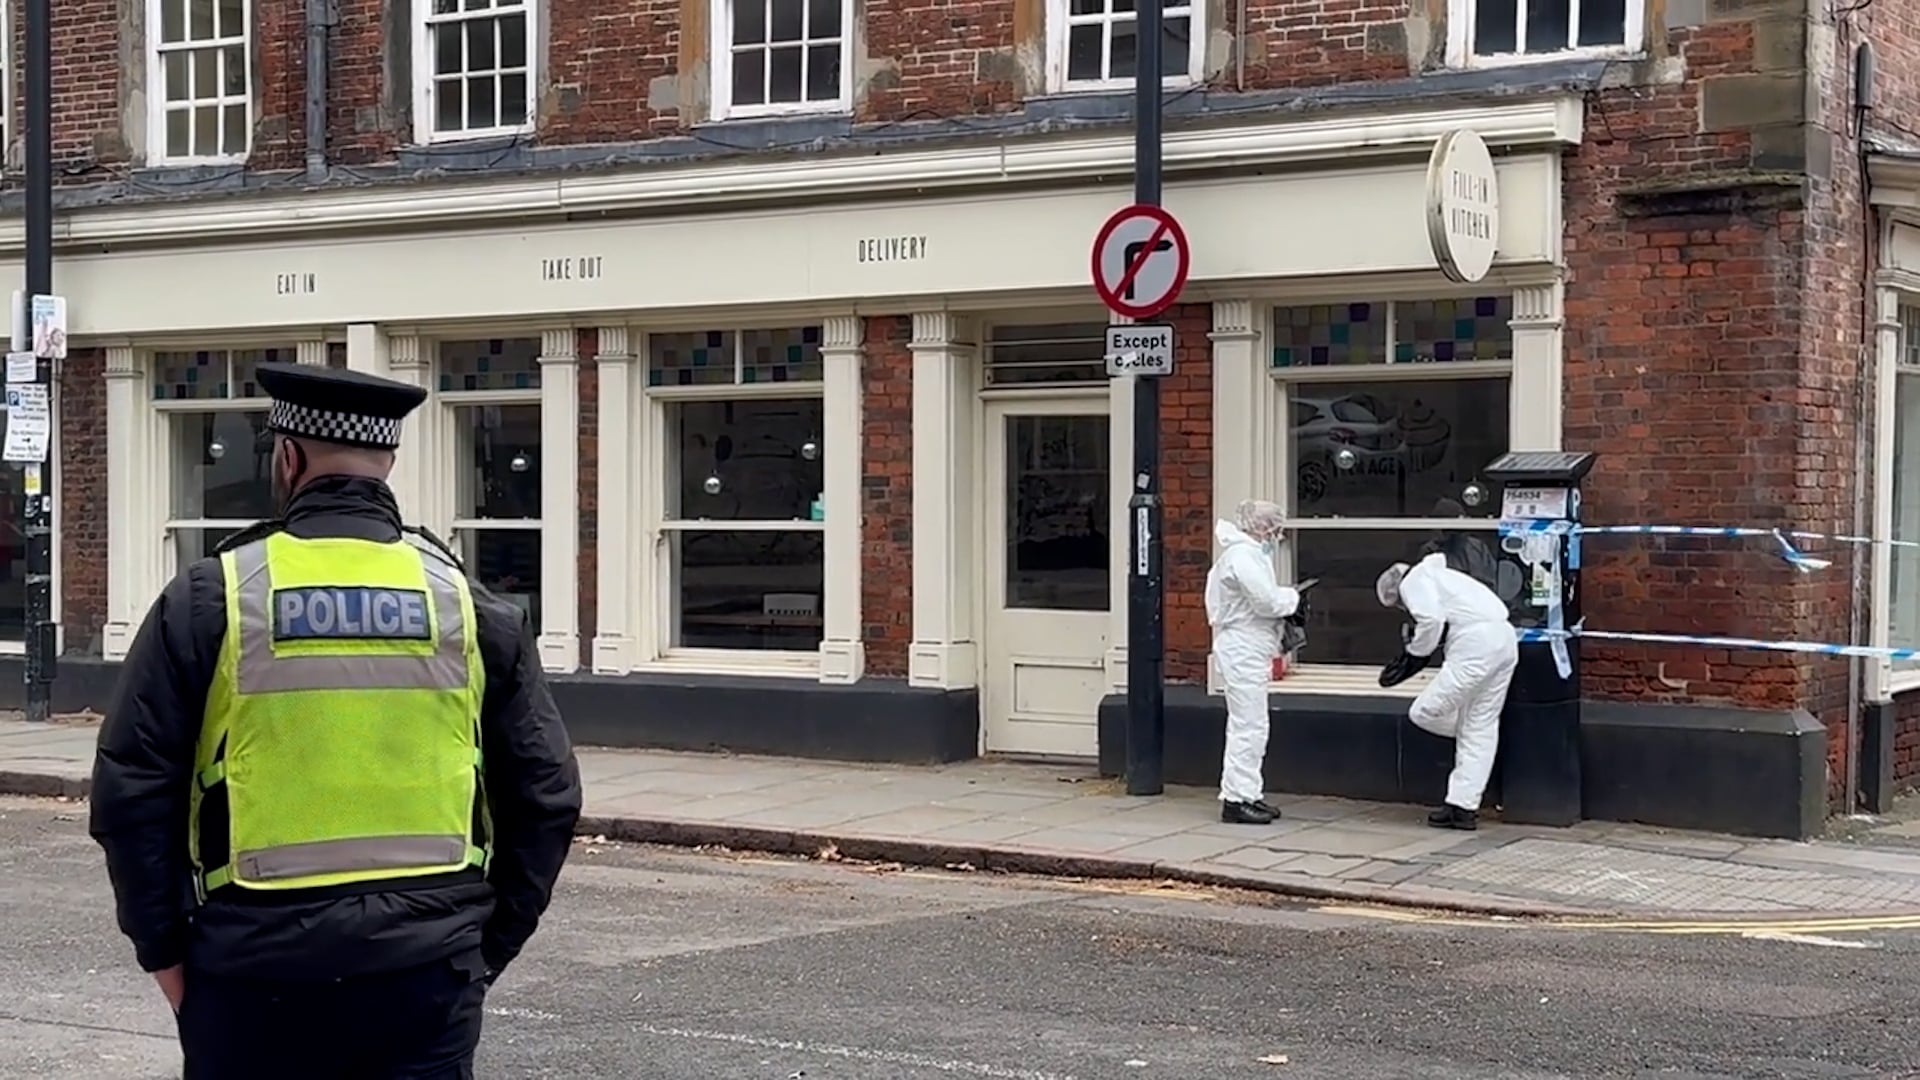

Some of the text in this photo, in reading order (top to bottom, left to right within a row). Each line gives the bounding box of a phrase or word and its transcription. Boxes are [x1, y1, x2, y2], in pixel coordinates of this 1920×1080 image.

[1452, 208, 1490, 239] KITCHEN
[858, 236, 927, 262] DELIVERY
[542, 256, 602, 280] TAKE OUT
[277, 273, 315, 295] EAT IN
[1113, 333, 1167, 350] Except
[280, 592, 425, 634] POLICE
